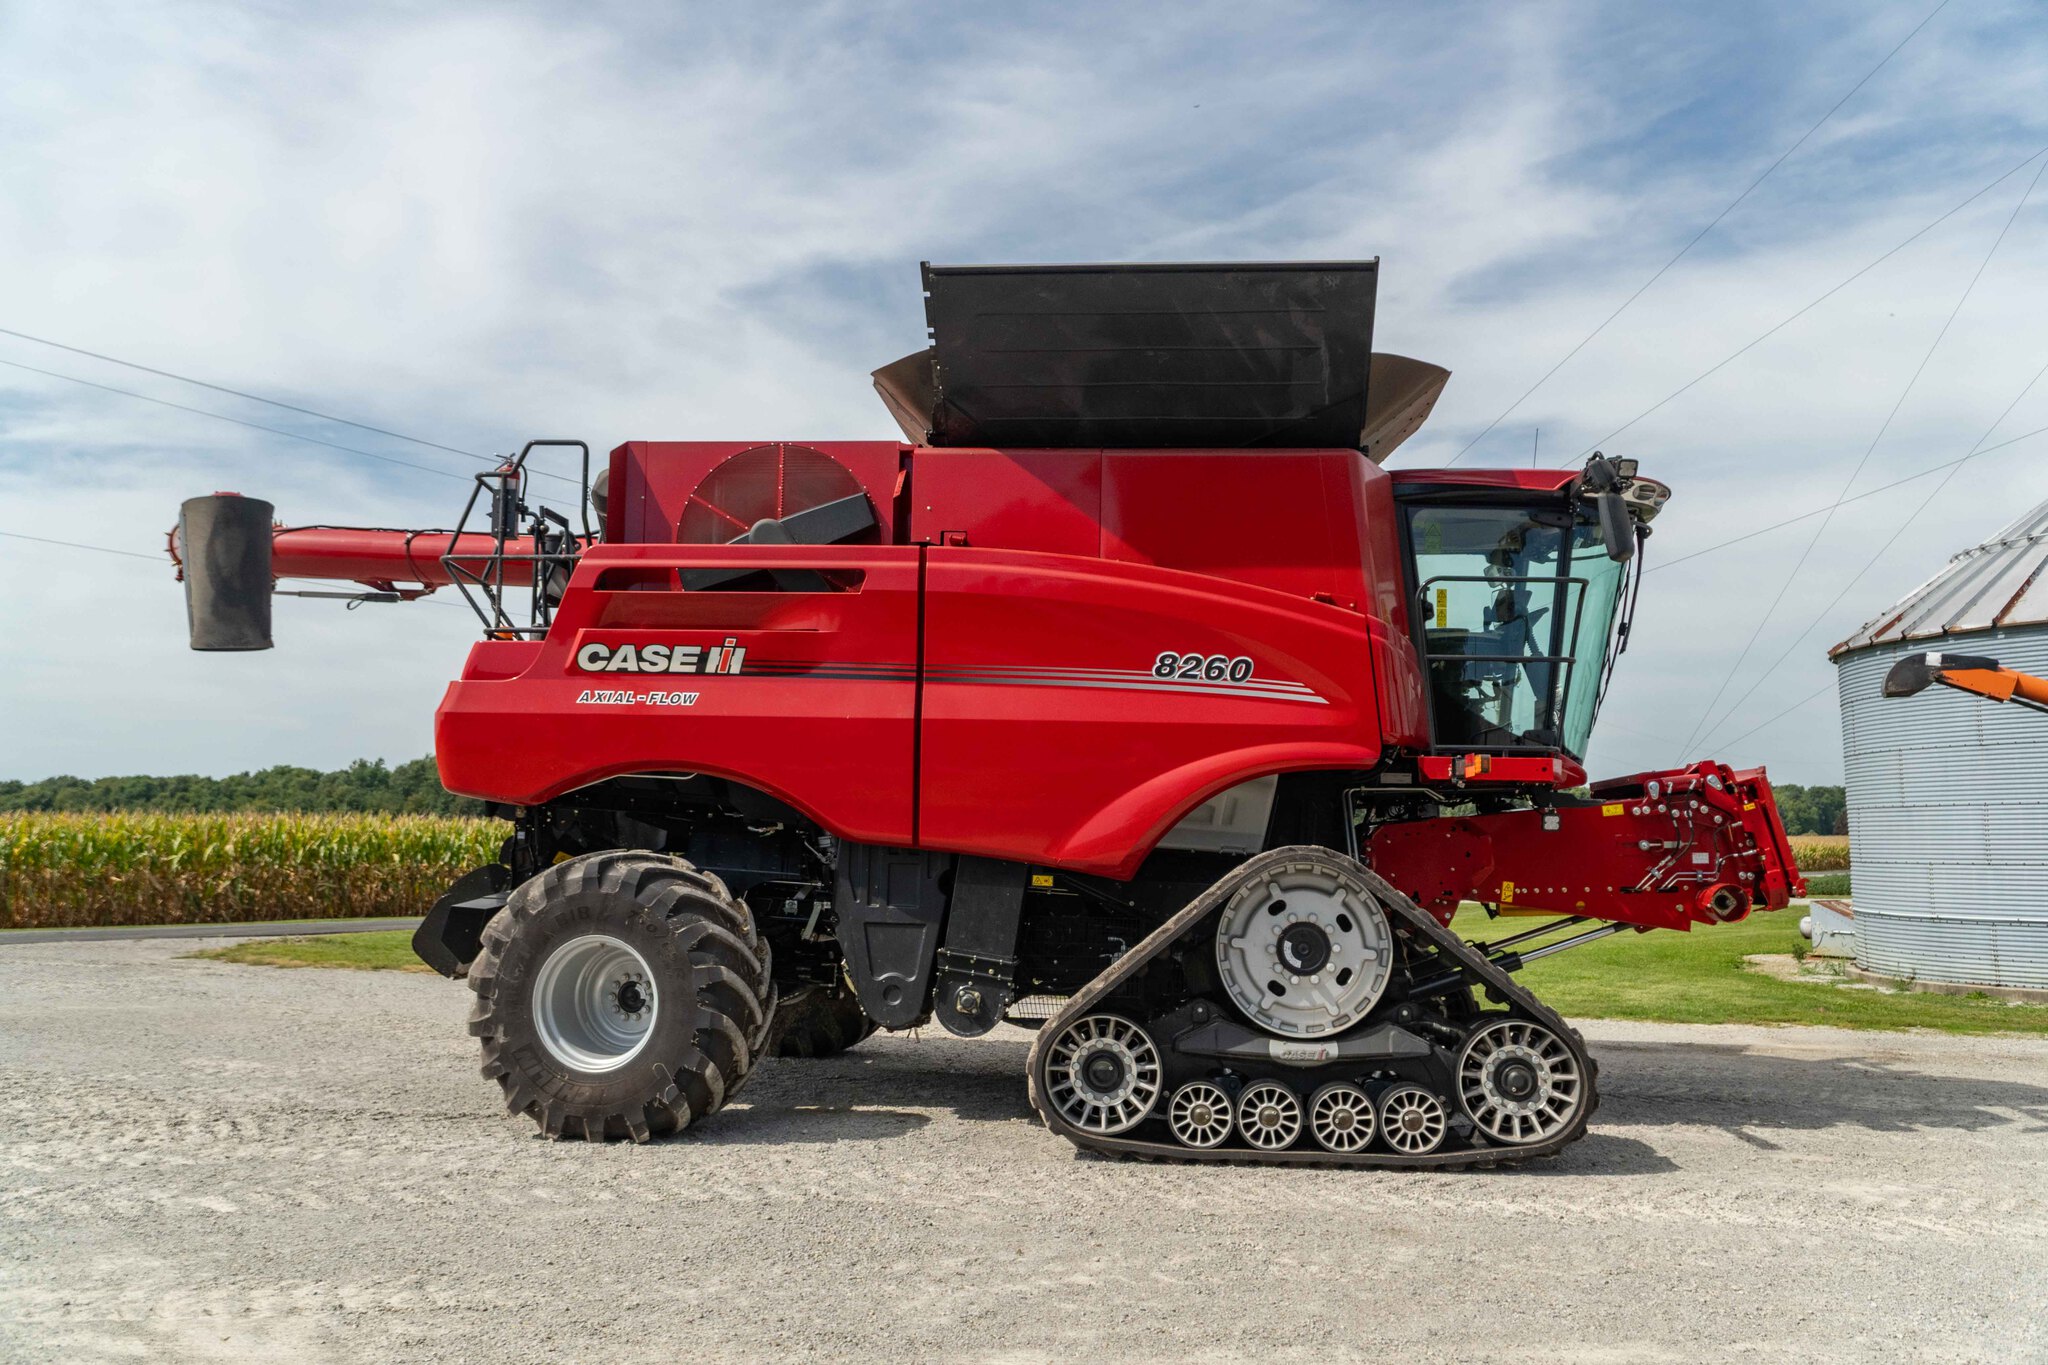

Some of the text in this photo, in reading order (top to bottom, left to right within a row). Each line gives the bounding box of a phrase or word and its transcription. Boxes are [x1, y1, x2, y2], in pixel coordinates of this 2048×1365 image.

[577, 643, 702, 673] CASE
[1152, 651, 1254, 683] 8260
[577, 690, 699, 706] AXIAL-FLOW
[1279, 1049, 1315, 1061] CASE
